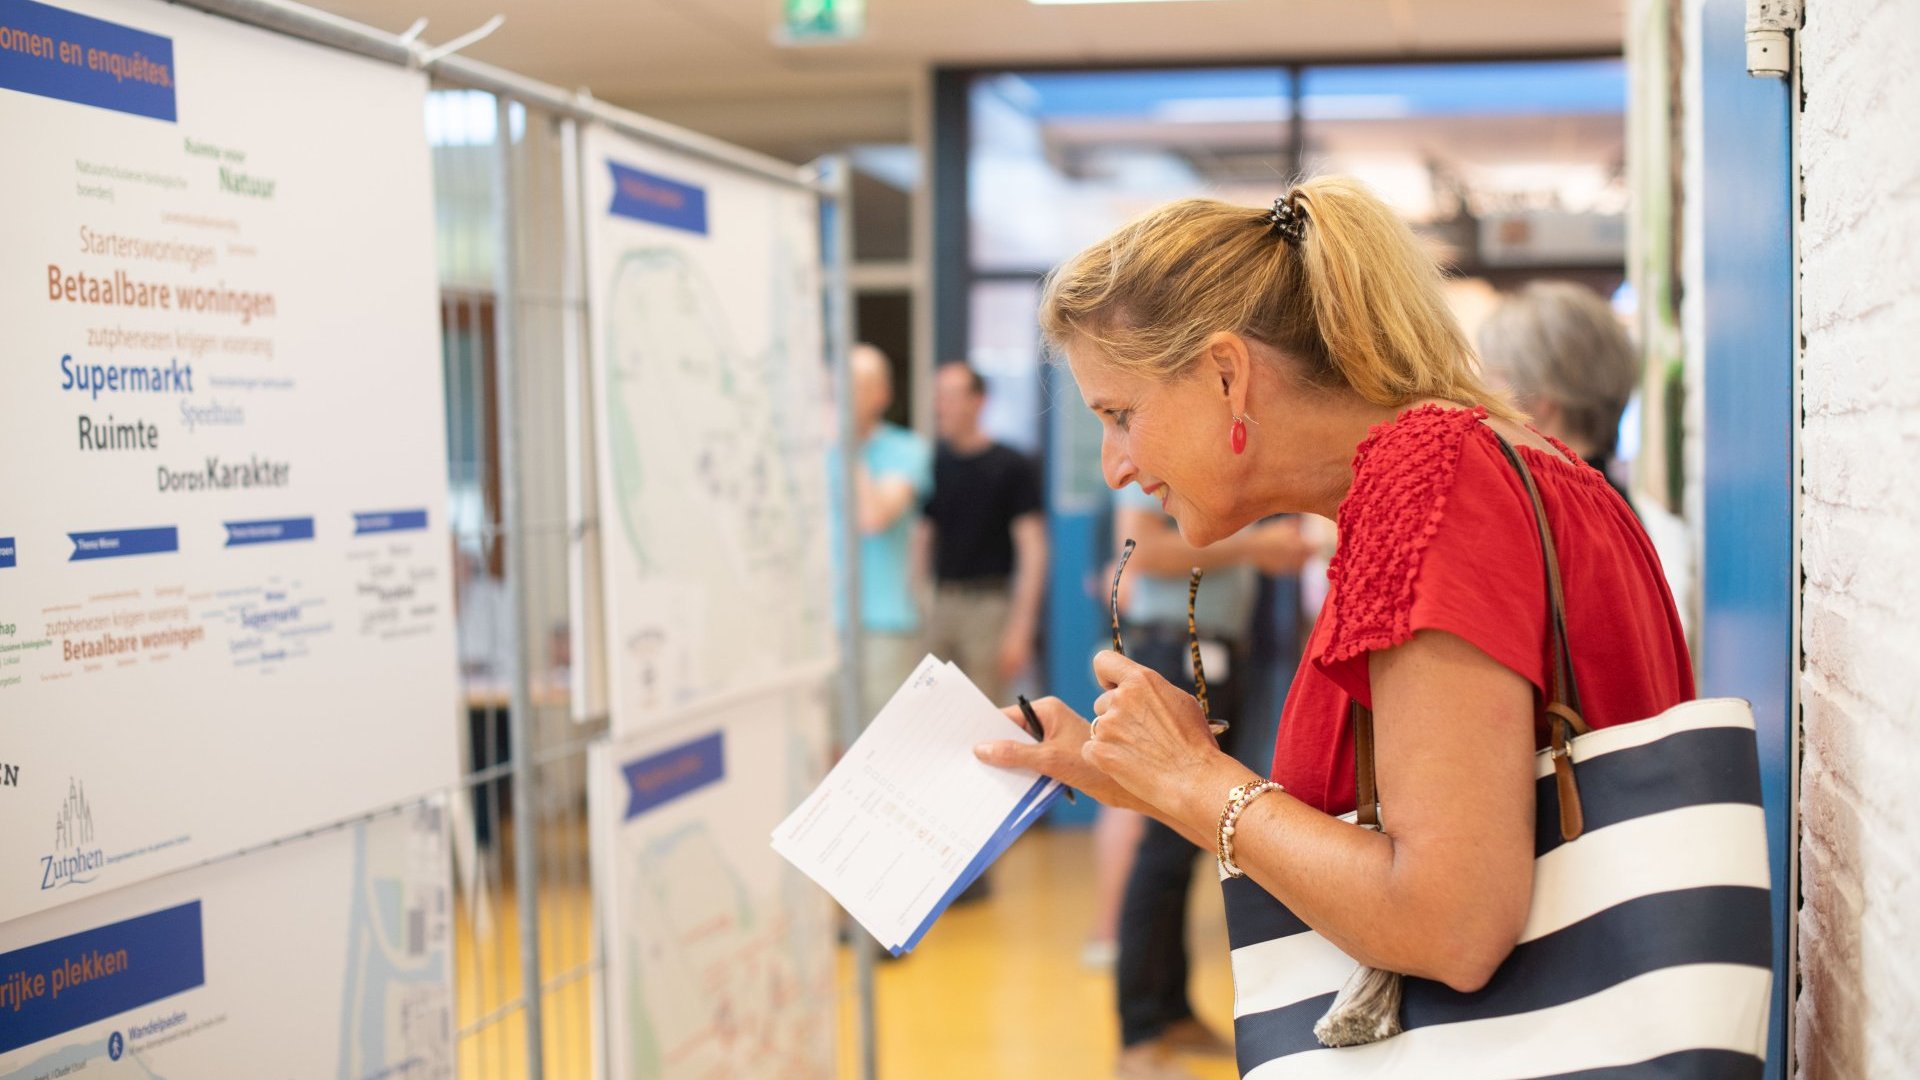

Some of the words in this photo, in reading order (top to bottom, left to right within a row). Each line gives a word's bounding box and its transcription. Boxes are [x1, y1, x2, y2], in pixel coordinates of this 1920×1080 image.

[59, 40, 82, 66] en
[219, 165, 275, 198] Natuur
[80, 225, 216, 271] Starterswoningen
[47, 265, 170, 309] Betaalbare
[176, 280, 276, 325] woningen
[61, 354, 194, 400] Supermarkt
[79, 415, 158, 451] Ruimte
[63, 632, 137, 662] Betaalbare
[141, 623, 204, 651] woningen
[40, 848, 104, 890] Zutphen
[0, 970, 45, 1012] rijke
[52, 947, 128, 999] plekken
